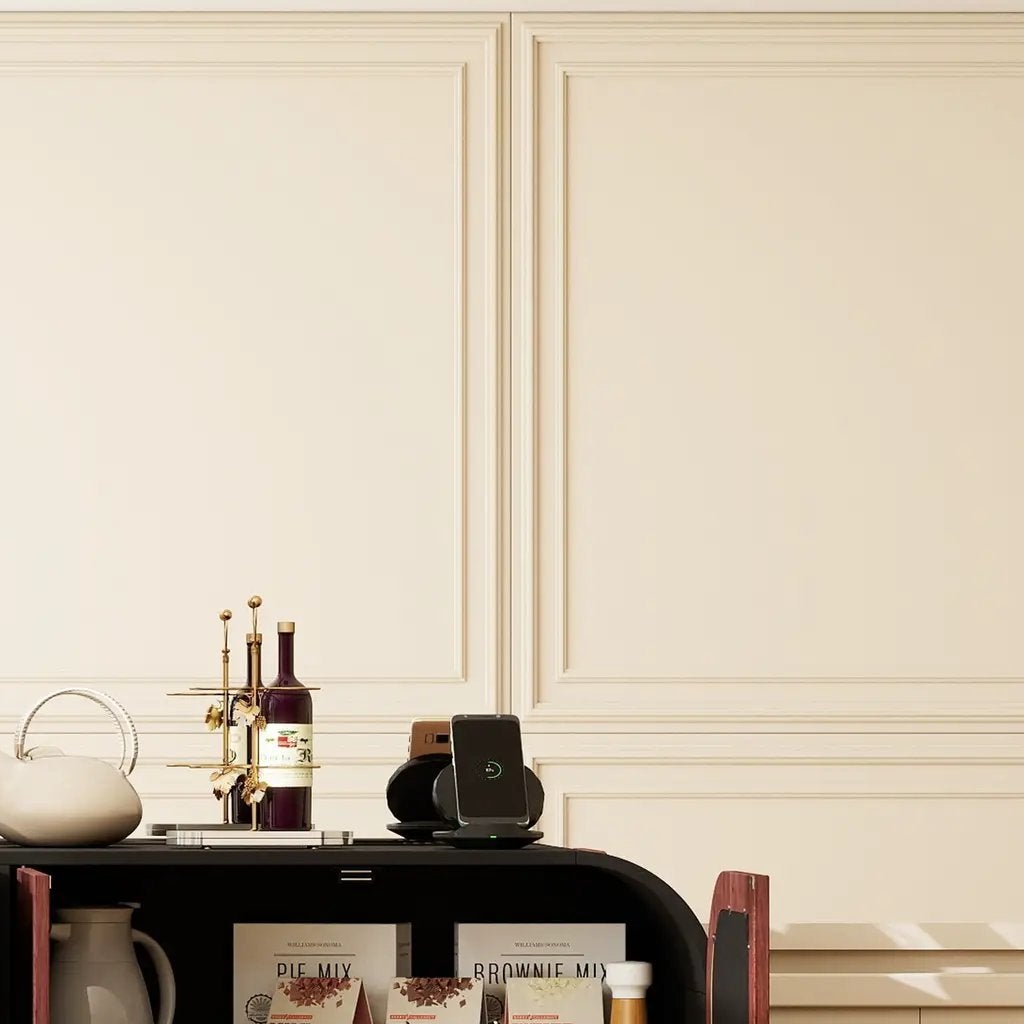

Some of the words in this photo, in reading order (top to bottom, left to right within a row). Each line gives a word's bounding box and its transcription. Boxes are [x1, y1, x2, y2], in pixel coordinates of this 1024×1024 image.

[277, 963, 307, 978] PIE
[318, 963, 352, 978] MIX
[474, 962, 564, 984] BROWNIE
